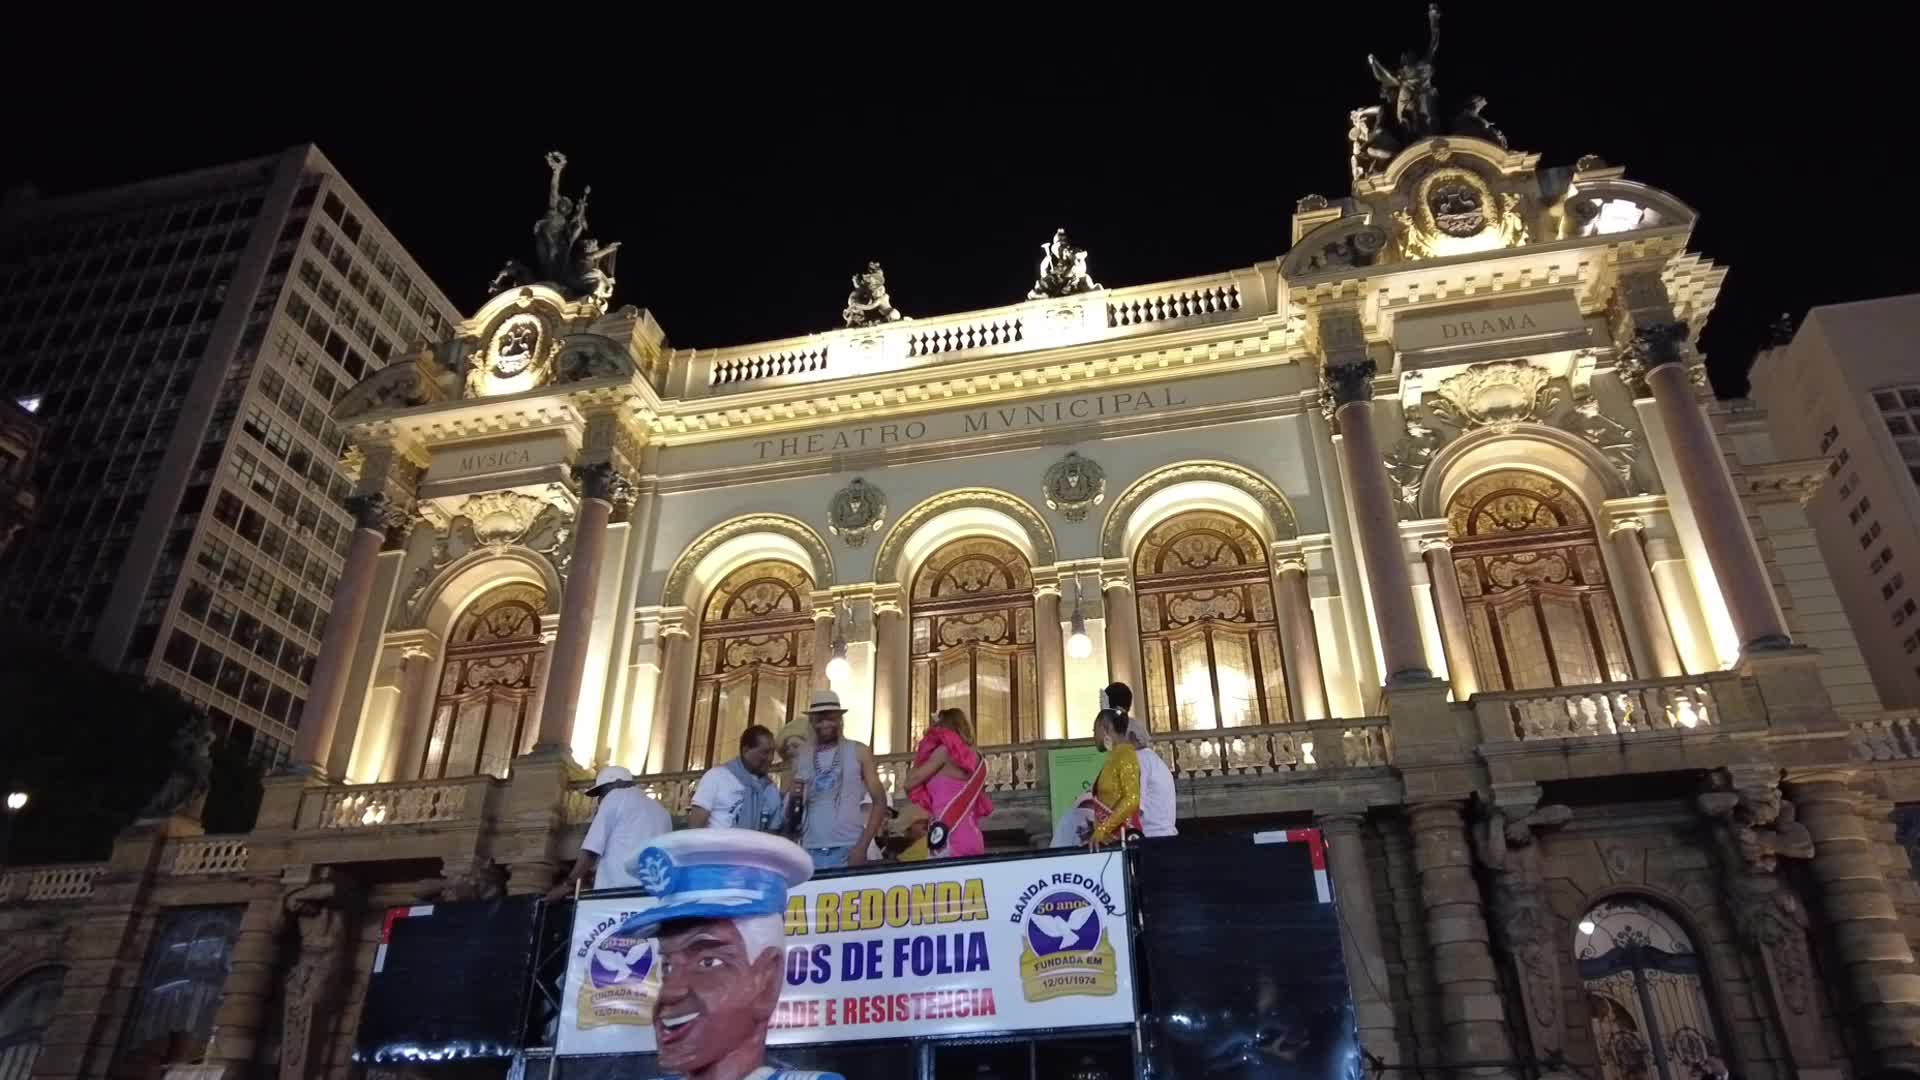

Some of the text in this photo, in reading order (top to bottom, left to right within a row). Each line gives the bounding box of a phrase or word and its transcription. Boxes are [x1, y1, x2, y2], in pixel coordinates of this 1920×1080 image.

[1441, 313, 1536, 338] DRAMA
[753, 387, 1185, 458] THEATRO MVNICIPAL
[784, 878, 989, 936] A REDONDA
[1009, 873, 1116, 923] BANDA REDONDA
[1036, 900, 1088, 914] 50 anos
[577, 917, 616, 958] BANDA
[786, 931, 990, 986] OS DE FOLIA
[1034, 956, 1103, 971] FUNDADA EM
[1043, 976, 1097, 988] 12/01/1974
[768, 1000, 819, 1029] ADE
[825, 999, 837, 1026] E
